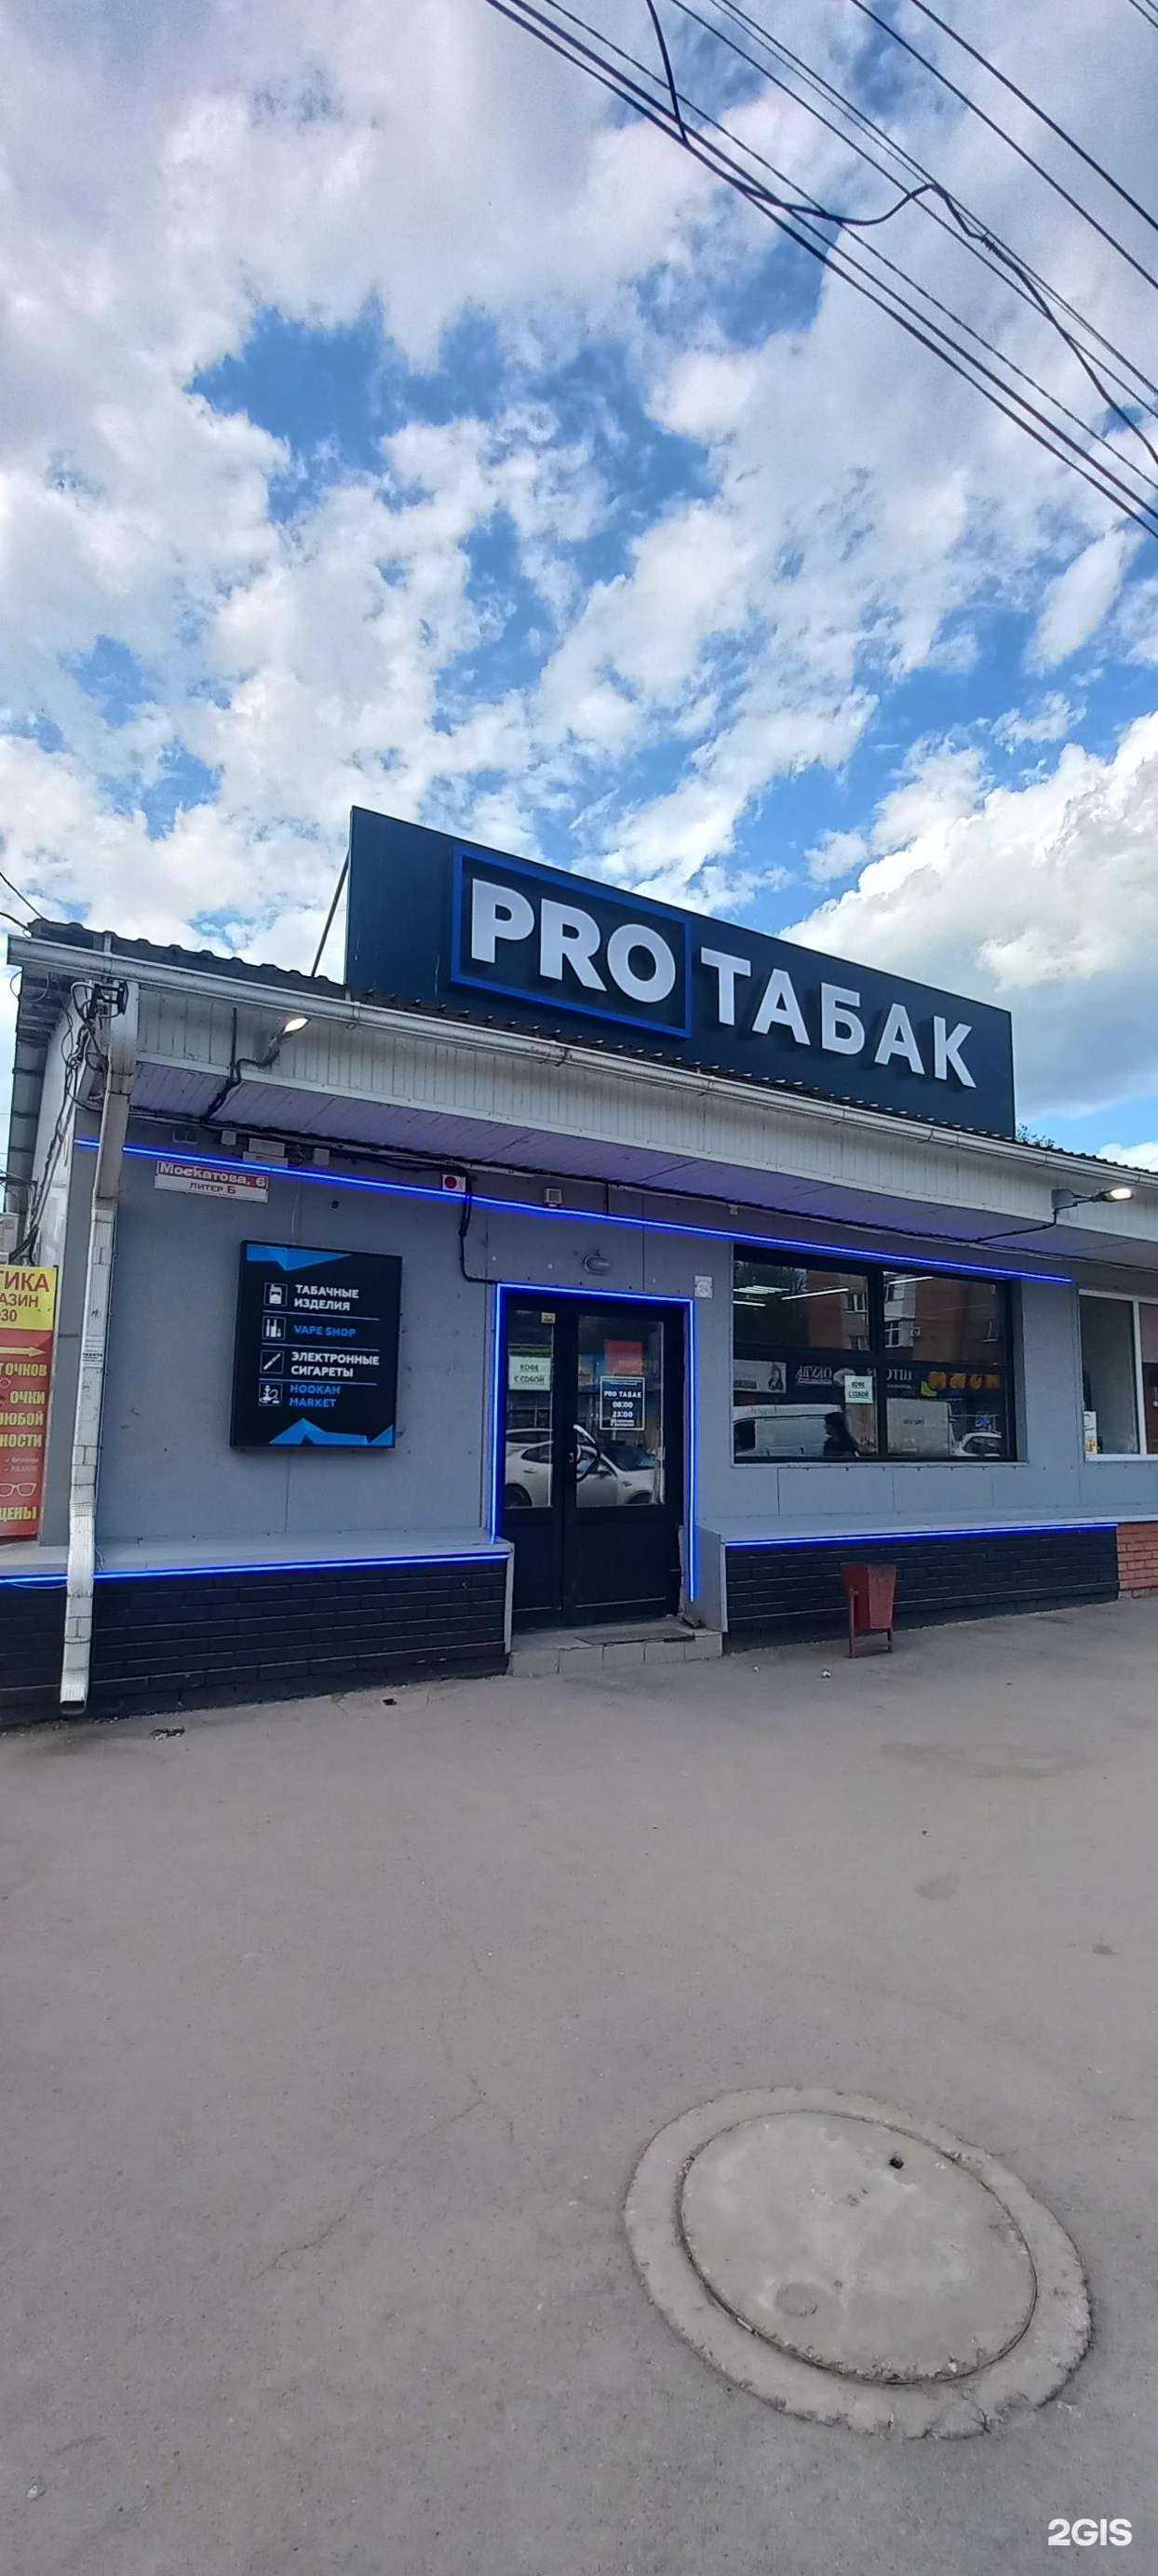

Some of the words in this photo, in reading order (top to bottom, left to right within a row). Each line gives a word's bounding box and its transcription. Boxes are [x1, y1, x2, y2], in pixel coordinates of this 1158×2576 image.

[470, 878, 677, 1003] PRO
[701, 946, 976, 1088] ТАБАК
[256, 1176, 265, 1187] 6
[227, 1185, 236, 1194] Б
[295, 1285, 359, 1299] ТАБАЧНЫЕ
[294, 1299, 350, 1311] ИЗДЕЛИЯ
[294, 1325, 323, 1336] VAPE
[326, 1327, 357, 1337] SHOP
[290, 1352, 381, 1366] ЭЛЕКТРОННЫЕ
[290, 1365, 354, 1378] СИГАРЕТЫ
[290, 1384, 341, 1395] HOOKAH
[290, 1398, 337, 1408] MARKET
